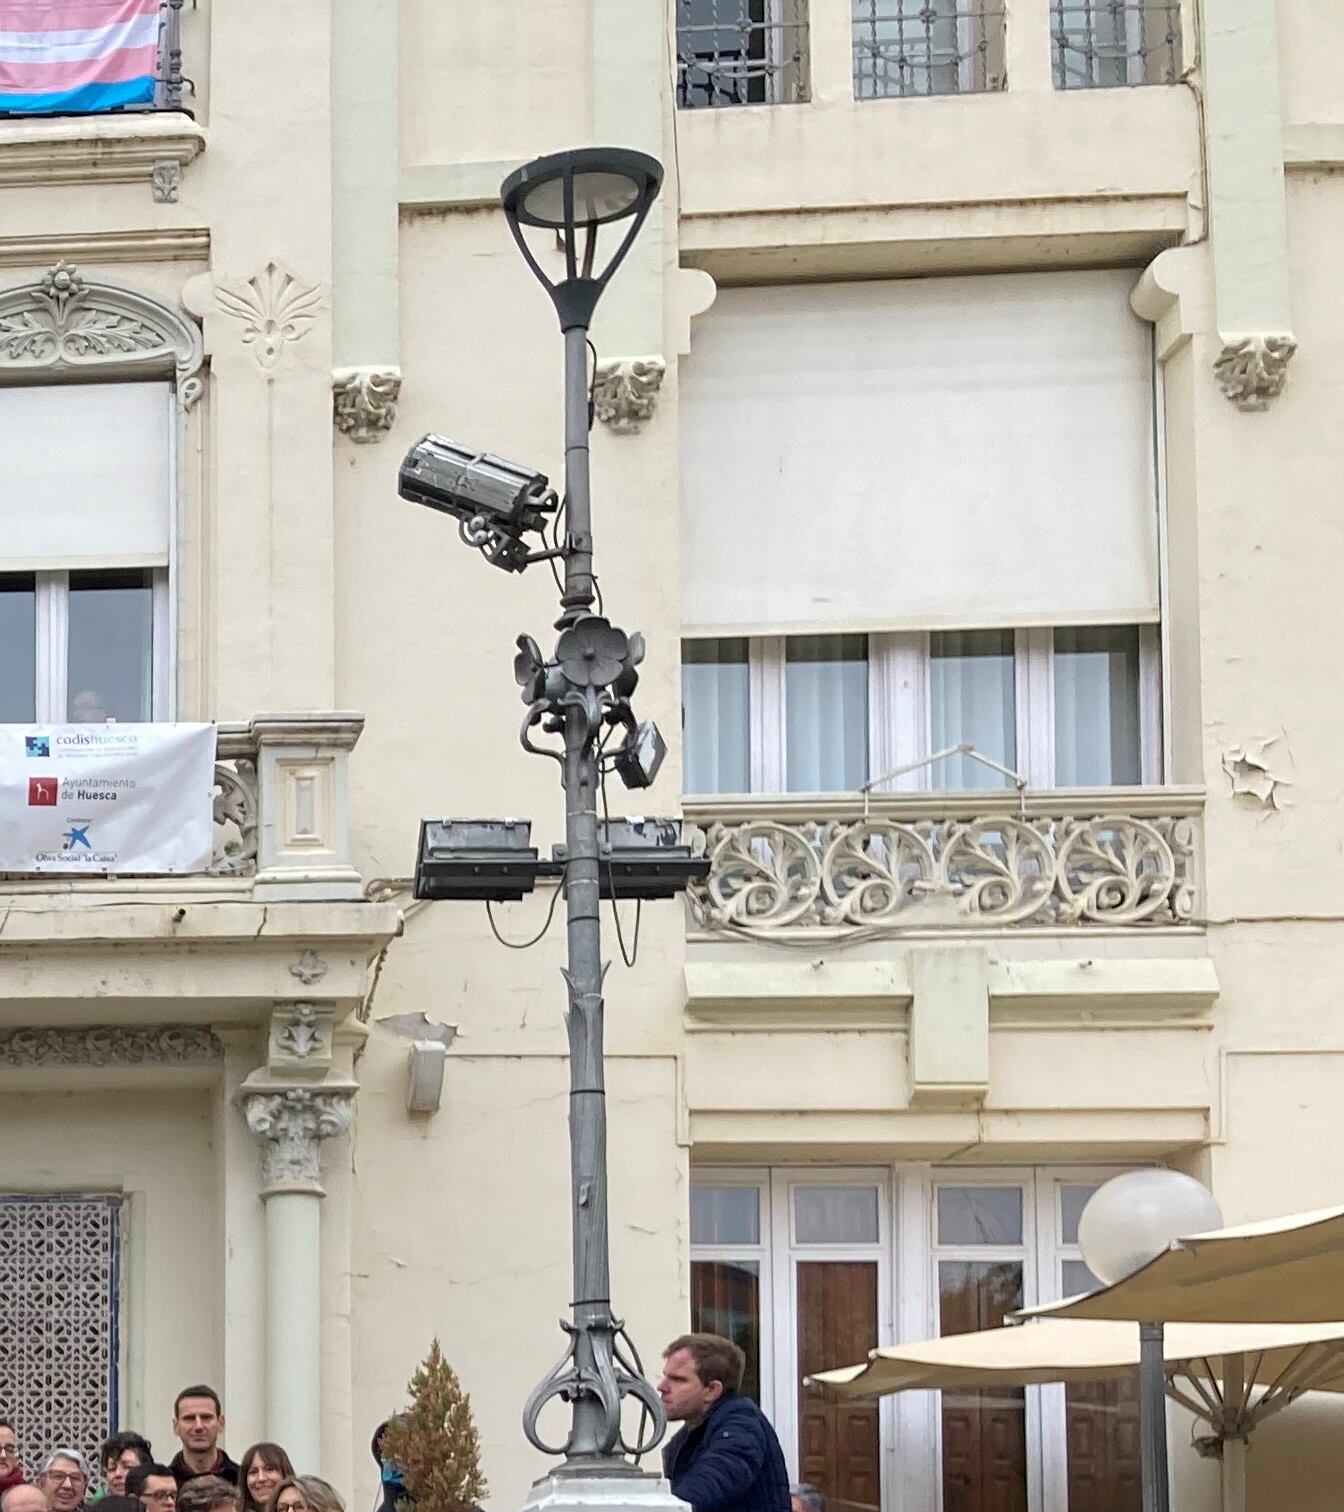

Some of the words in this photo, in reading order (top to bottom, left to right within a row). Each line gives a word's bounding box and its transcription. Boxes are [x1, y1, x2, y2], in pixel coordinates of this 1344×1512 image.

[62, 777, 136, 789] Ayuntamiento
[61, 790, 75, 800] de
[77, 790, 118, 801] Huesca
[57, 853, 81, 862] Social
